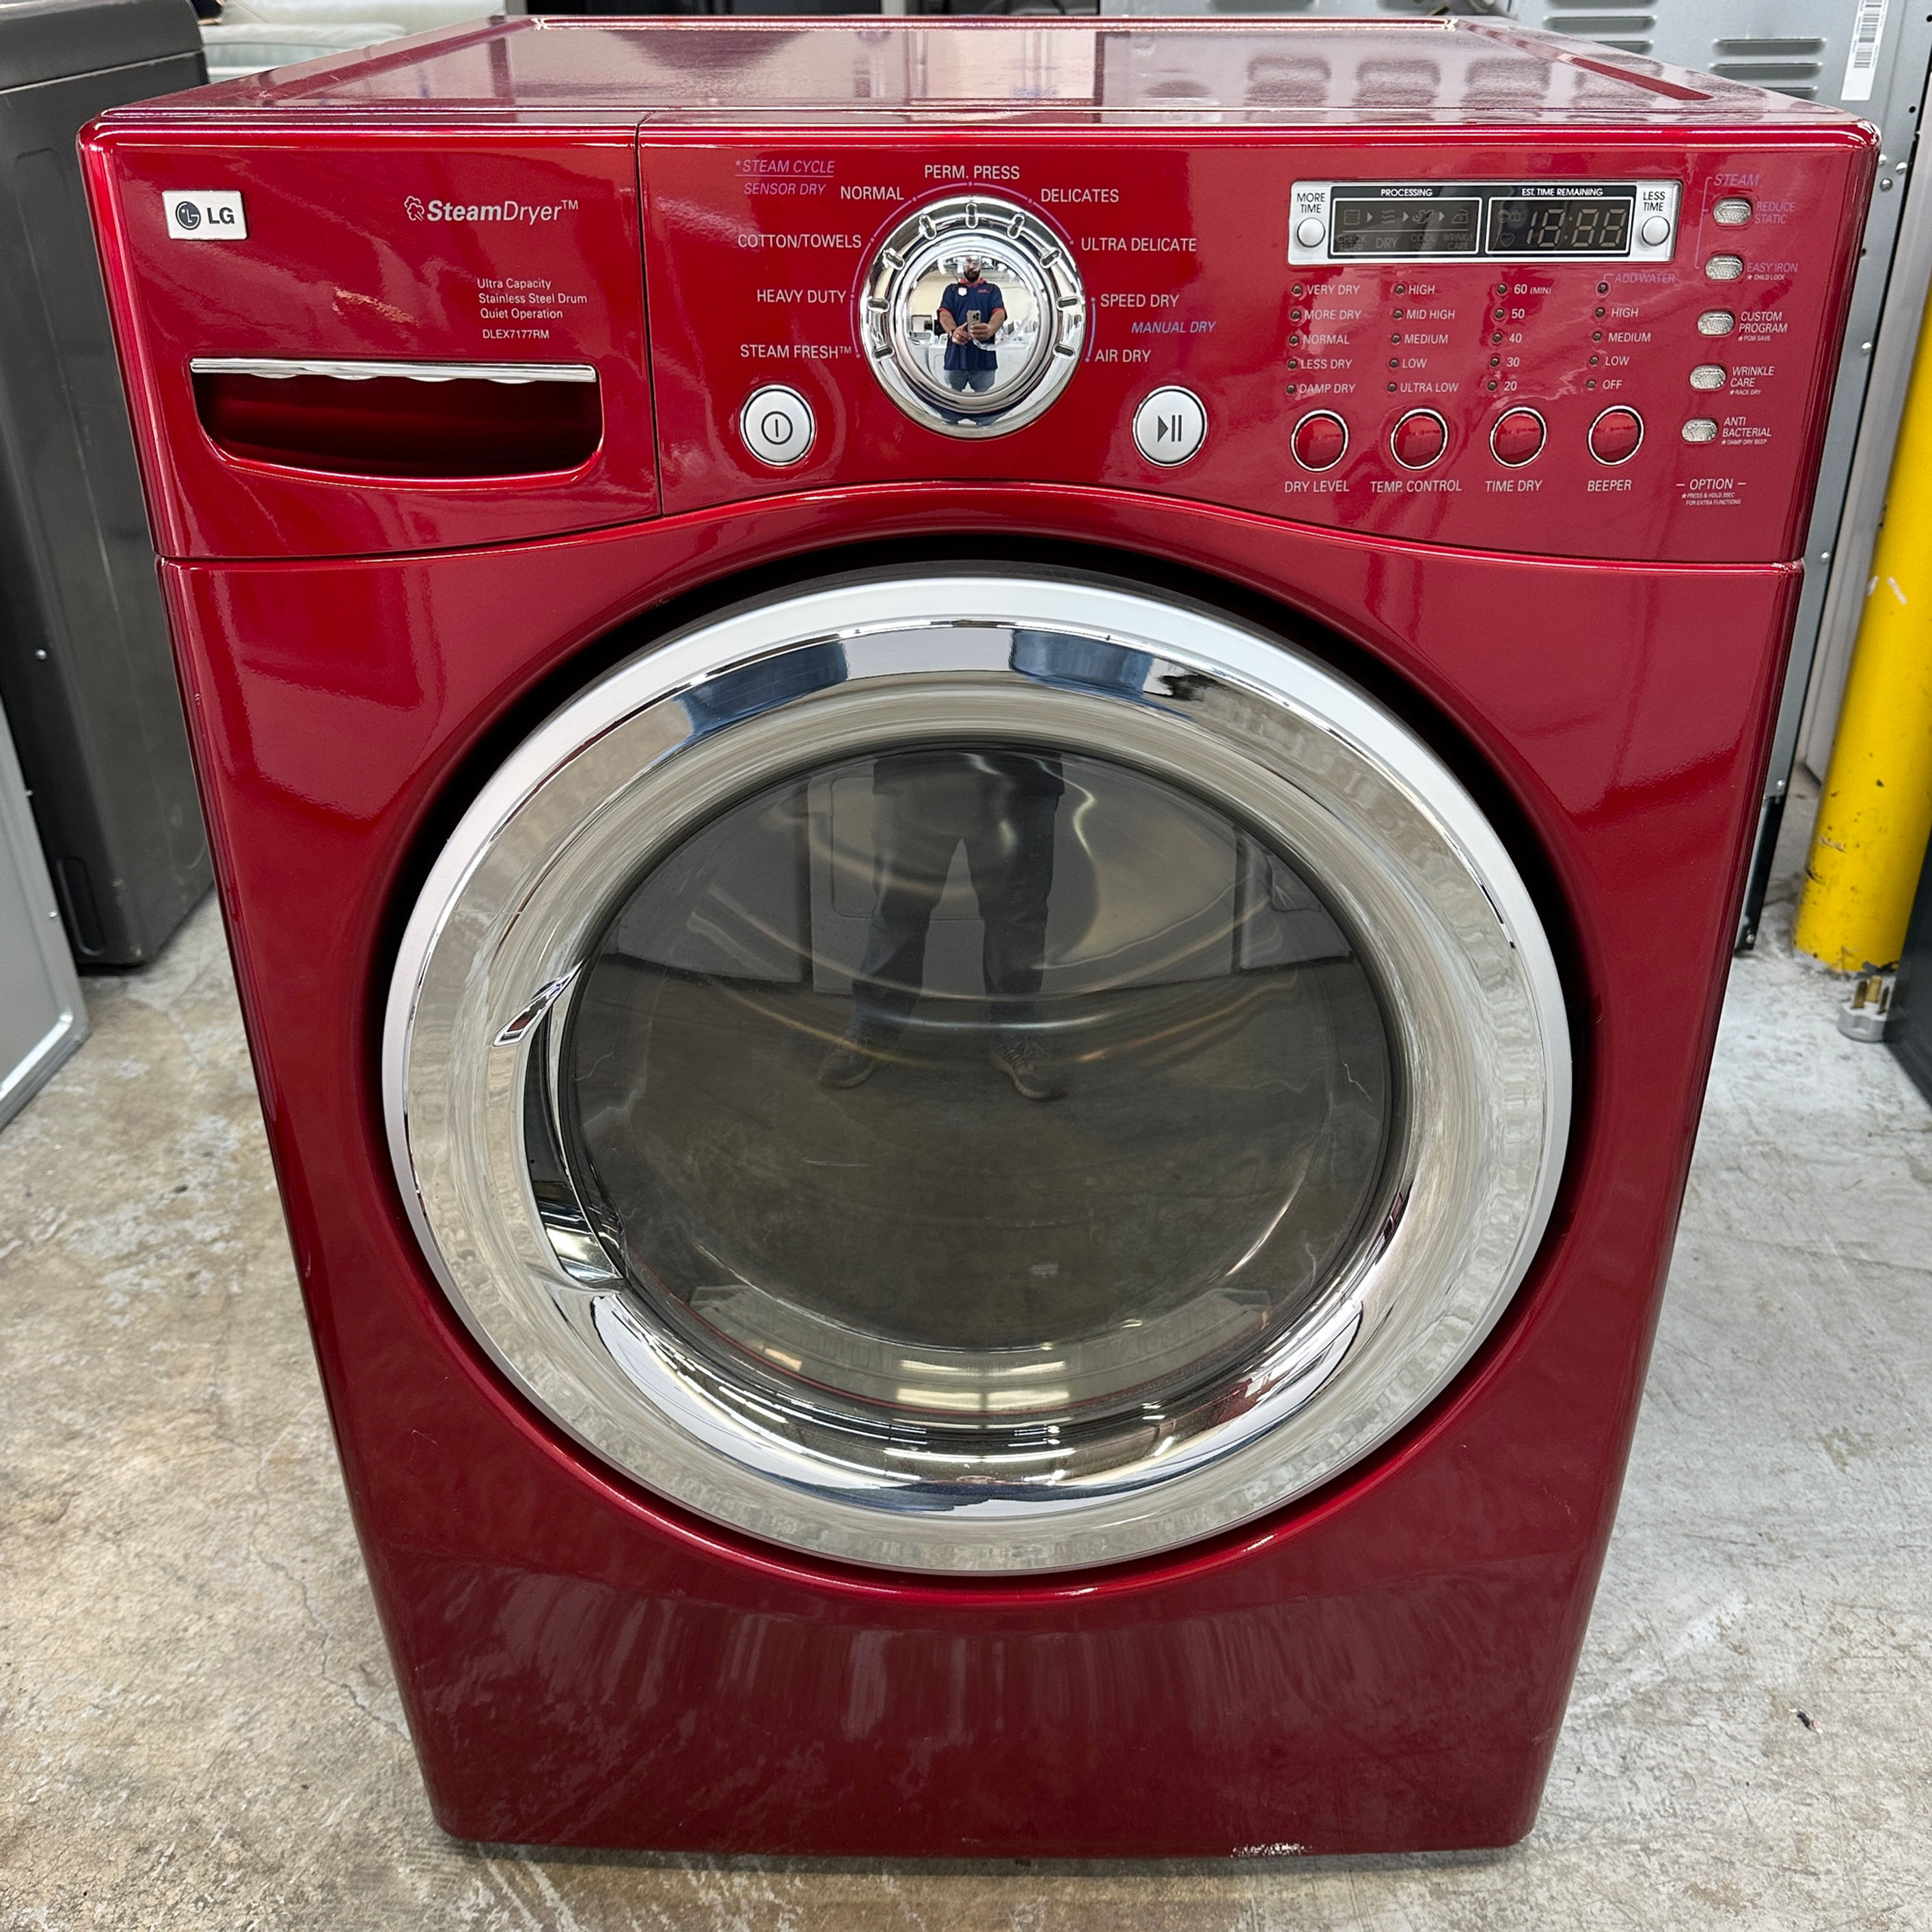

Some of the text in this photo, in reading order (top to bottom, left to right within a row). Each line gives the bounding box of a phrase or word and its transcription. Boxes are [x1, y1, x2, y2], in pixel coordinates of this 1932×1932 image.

[793, 160, 835, 174] CYCLE
[925, 165, 1020, 180] PERM. PRESS
[1713, 174, 1760, 186] STEAM
[744, 182, 826, 195] SENSOR DRY
[841, 186, 904, 200] NORMAL
[1380, 188, 1433, 197] PROCESSING
[1537, 188, 1555, 196] TIME
[1556, 188, 1603, 196] REMAINING
[1041, 189, 1119, 203] DELICATES
[1296, 193, 1326, 203] MORE
[1643, 191, 1665, 201] LESS
[1301, 204, 1321, 214] TIME
[1644, 202, 1663, 212] TIME
[1756, 202, 1796, 213] REDUCE
[207, 206, 235, 226] LG
[1754, 214, 1787, 224] STATIC
[737, 234, 862, 248] COTTON/TOWELS
[1081, 237, 1197, 252] ULTRA DELICATE
[1376, 238, 1398, 248] DRY
[1747, 262, 1798, 273] EASY IRON
[477, 278, 552, 290] Ultra Capacity
[1307, 285, 1360, 295] VERY DRY
[1409, 285, 1435, 295] HIGH
[1514, 284, 1551, 295] 60 (MIN)
[478, 293, 587, 303] Stainless Steel Drum
[757, 289, 846, 303] HEAVY DUTY
[1100, 294, 1180, 308] SPEED DRY
[480, 308, 562, 320] Quiet Operation
[1305, 310, 1361, 320] MORE DRY
[1406, 310, 1455, 319] MID HIGH
[1511, 309, 1525, 319] 50
[1611, 308, 1639, 317] HIGH
[1741, 312, 1782, 321] CUSTOM
[1131, 321, 1216, 334] MANUAL DRY
[1739, 323, 1788, 333] PROGRAM
[482, 329, 549, 339] DLEX7177RM
[1404, 334, 1448, 344] MEDIUM
[1509, 334, 1522, 343] 40
[1608, 332, 1651, 342] MEDIUM
[1303, 334, 1350, 345] NORMAL
[741, 344, 789, 358] STEAM
[1095, 349, 1151, 362] AIR DRY
[1301, 359, 1352, 369] LESS DRY
[1402, 359, 1427, 368] LOW
[1506, 357, 1520, 367] 30
[1605, 357, 1629, 366] LOW
[1732, 366, 1775, 376] WRINKLE
[1400, 383, 1459, 392] ULTRA LOW
[1504, 381, 1517, 392] 20
[1603, 380, 1622, 390] OFF
[1730, 378, 1756, 387] CARE
[1300, 383, 1356, 394] DAMP DRY
[1724, 417, 1747, 426] ANTI
[1722, 428, 1772, 437] BACTERIAL
[1284, 480, 1350, 493] DRY LEVEL
[1370, 480, 1462, 493] TEMP. CONTROL
[1485, 480, 1543, 493] TIME DRY
[1587, 480, 1632, 492] BEEPER
[1689, 478, 1733, 490] OPTION
